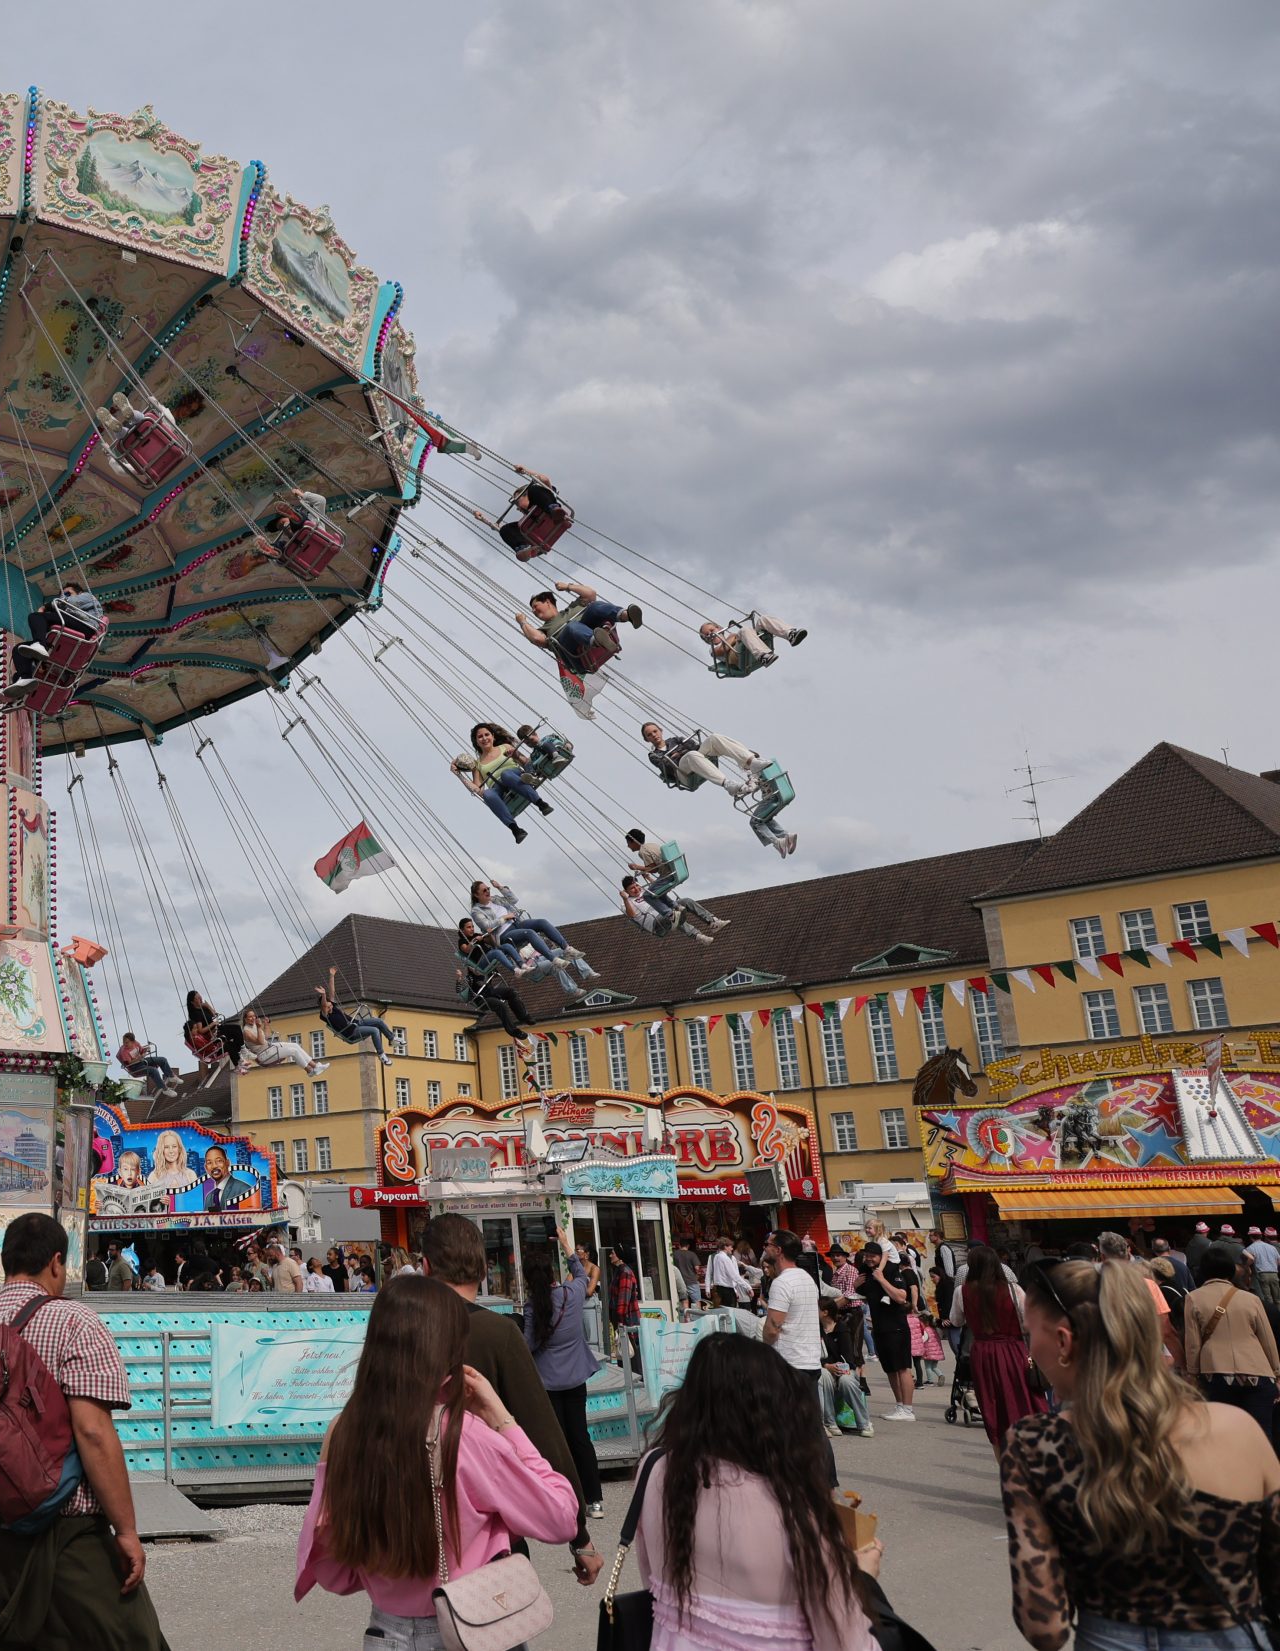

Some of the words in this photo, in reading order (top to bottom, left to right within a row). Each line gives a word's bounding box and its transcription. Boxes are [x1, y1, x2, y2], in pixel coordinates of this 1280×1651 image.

[1053, 1173, 1088, 1185] SEINE
[1101, 1172, 1151, 1183] RIVALEN
[1165, 1170, 1223, 1182] BESIEGEN
[1237, 1169, 1259, 1180] IST
[677, 1181, 727, 1196] brannte
[374, 1190, 418, 1203] Popcorn
[193, 1216, 215, 1227] J.A.
